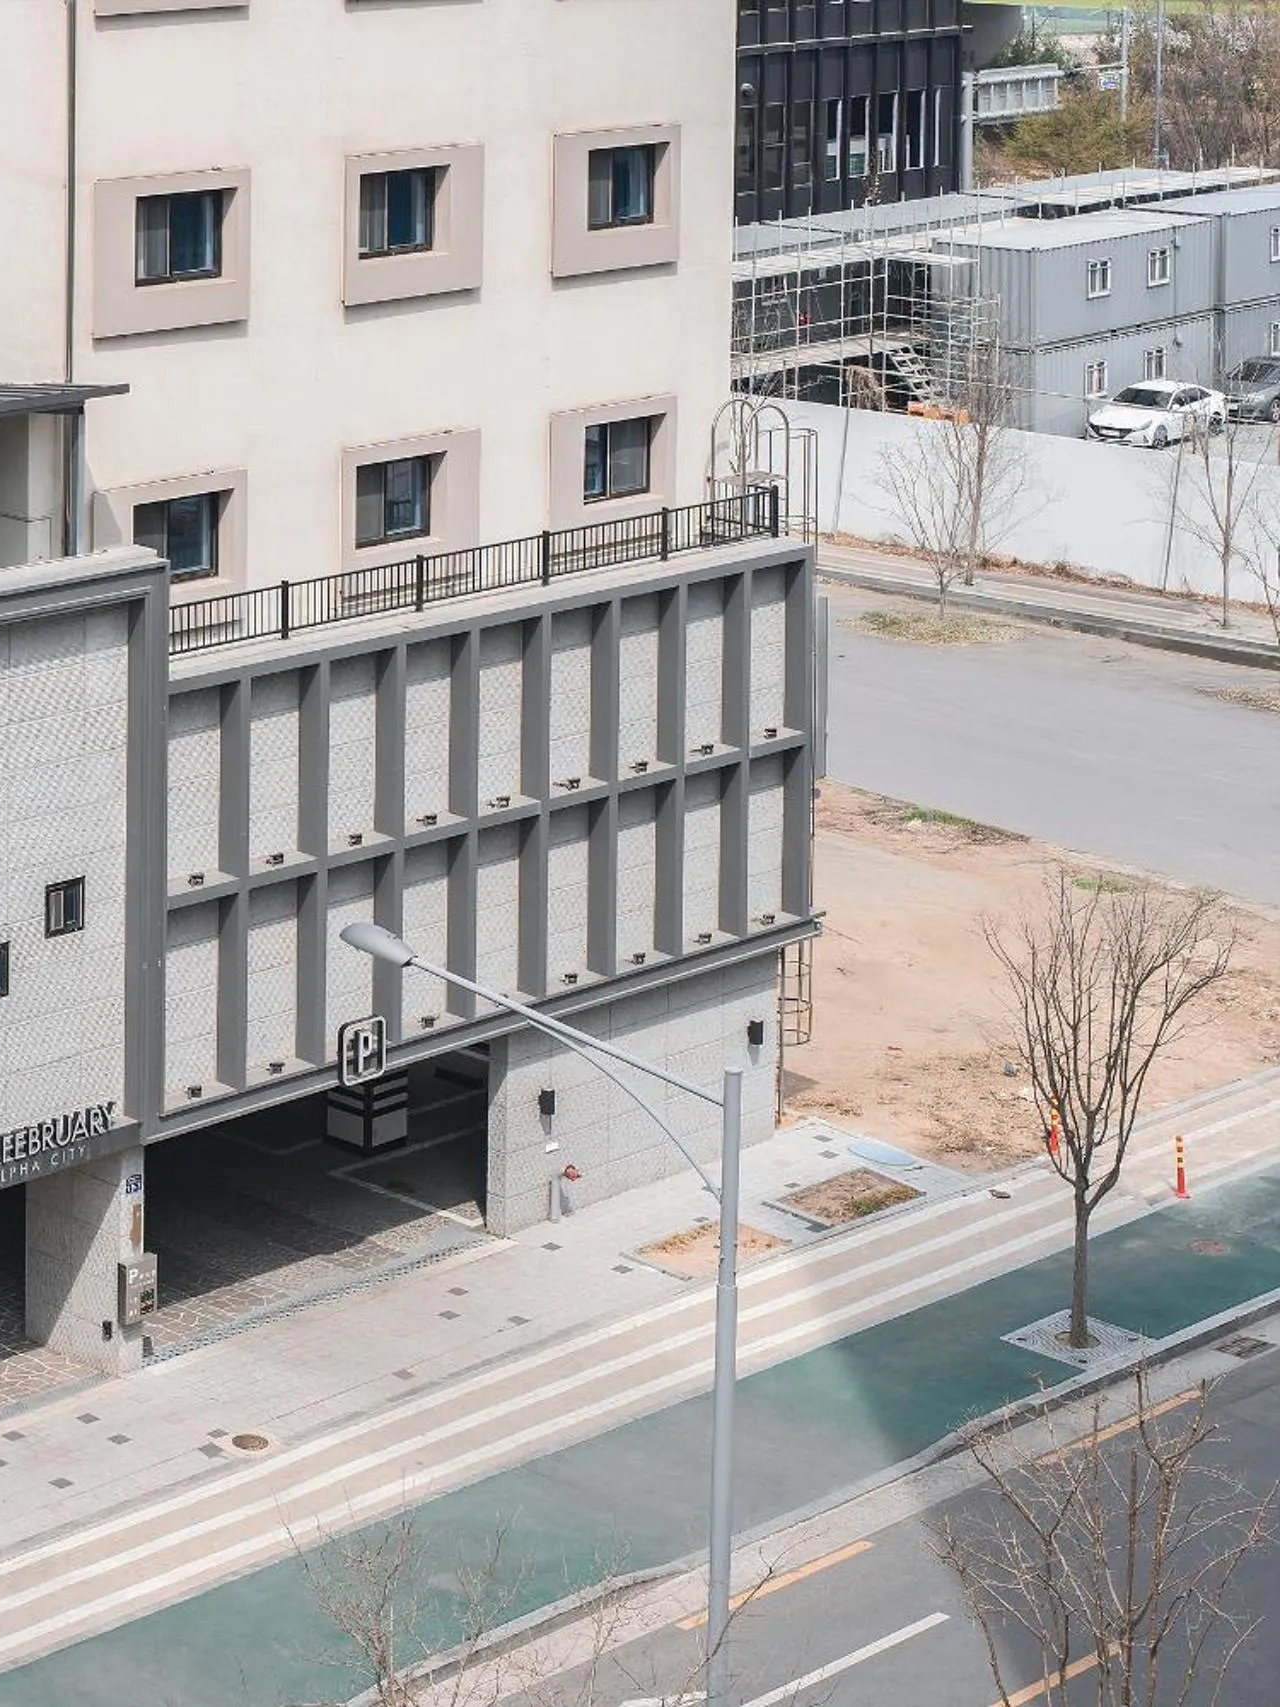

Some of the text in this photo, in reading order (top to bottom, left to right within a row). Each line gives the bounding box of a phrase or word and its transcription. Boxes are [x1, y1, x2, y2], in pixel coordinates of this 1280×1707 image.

[356, 1030, 374, 1075] P
[0, 1101, 116, 1166] FEBRUARY
[50, 1145, 87, 1167] CITY
